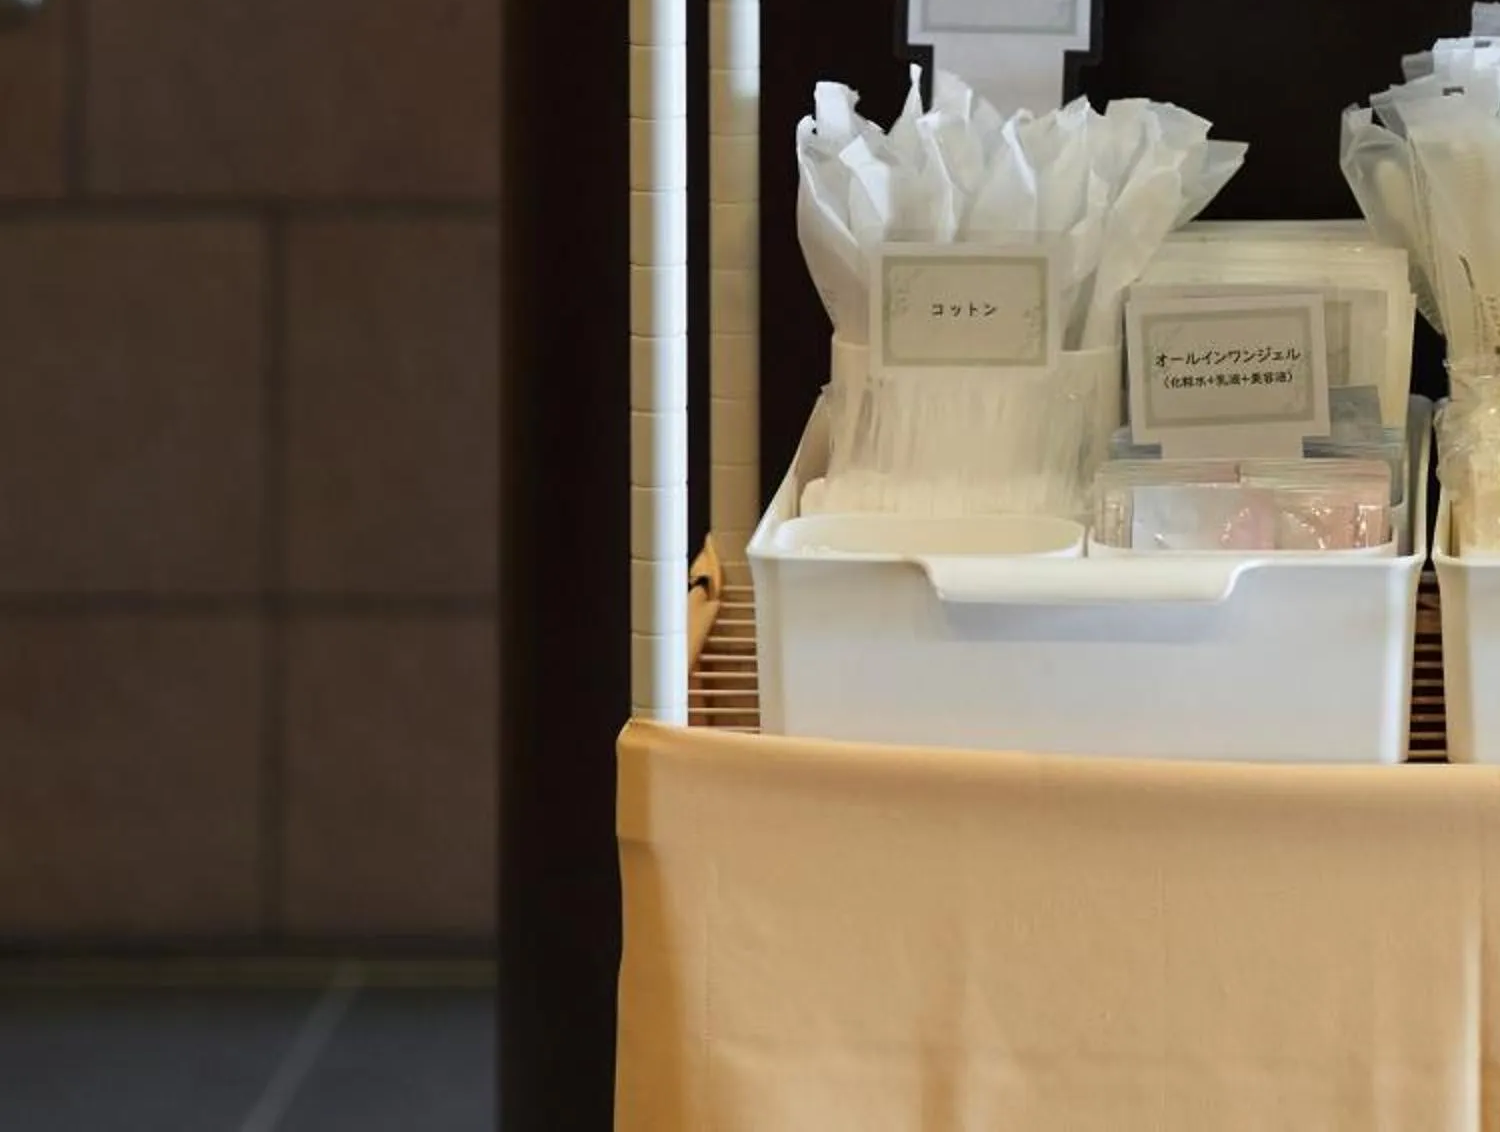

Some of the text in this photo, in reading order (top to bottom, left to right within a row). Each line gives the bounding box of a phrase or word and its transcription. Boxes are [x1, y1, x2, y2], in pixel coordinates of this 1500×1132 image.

[931, 301, 997, 317] コットン
[1155, 345, 1301, 367] オールインワンジェル
